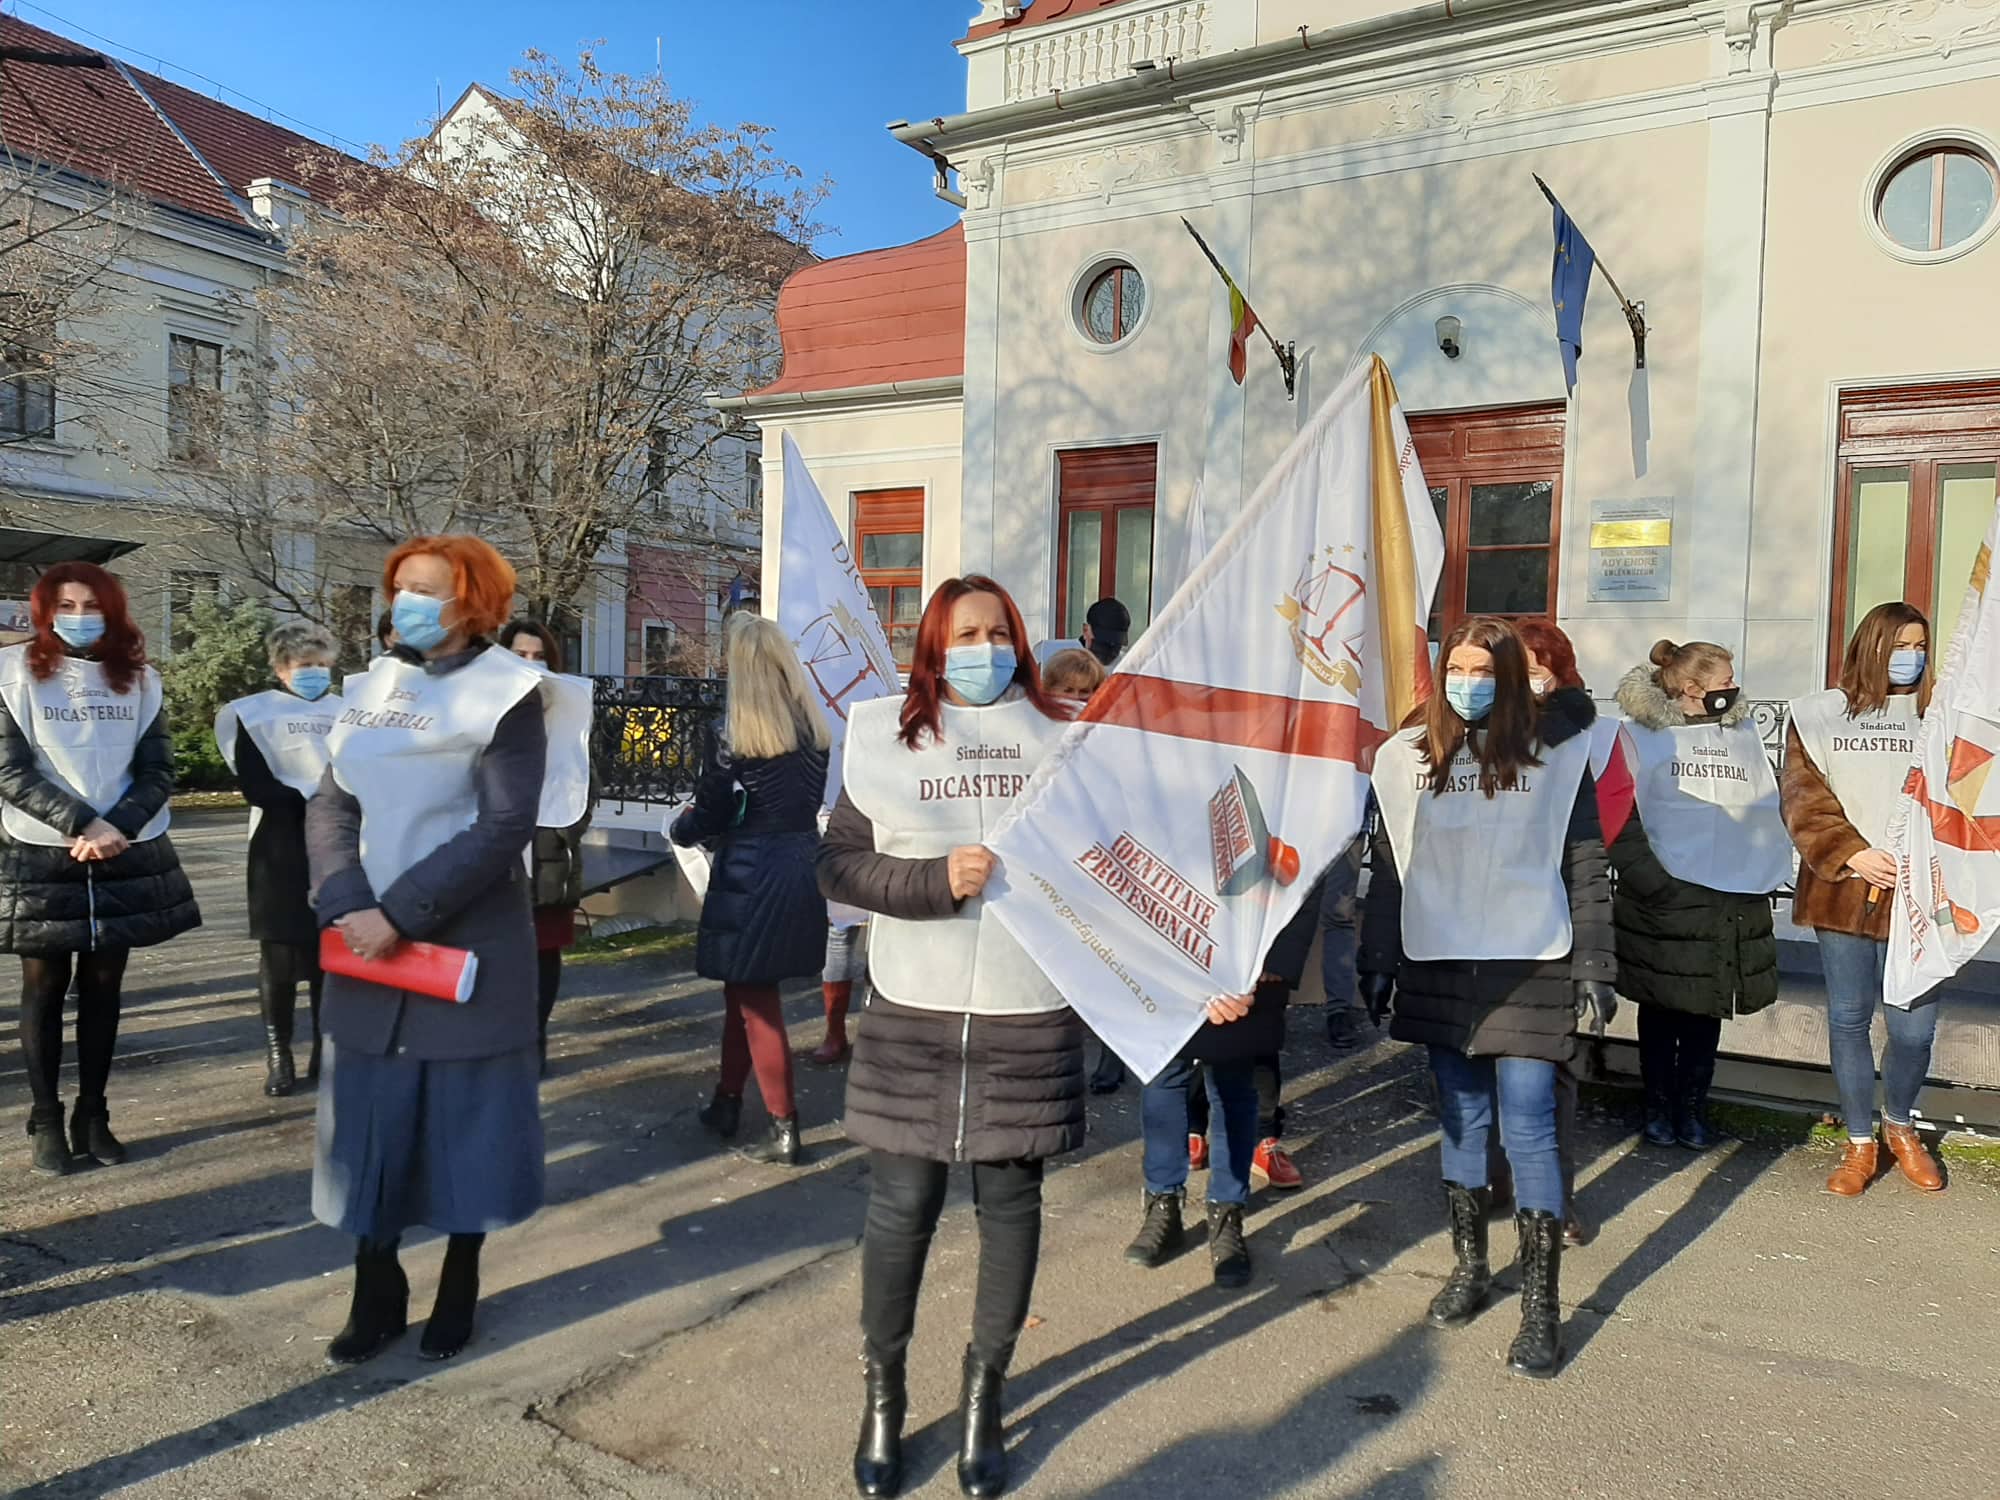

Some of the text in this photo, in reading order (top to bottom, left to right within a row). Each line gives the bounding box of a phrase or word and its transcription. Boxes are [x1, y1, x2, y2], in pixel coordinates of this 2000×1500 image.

[43, 705, 135, 721] DICASTERIAL
[1859, 722, 1906, 731] Sindicatul
[956, 743, 1021, 761] Sindicatul
[1692, 745, 1728, 757] Sindicatul
[1670, 761, 1748, 782] DICASTERIAL
[919, 774, 1031, 801] DICASTER
[1110, 833, 1217, 930] IDENTITATE
[1078, 847, 1216, 970] PROFESIONALA
